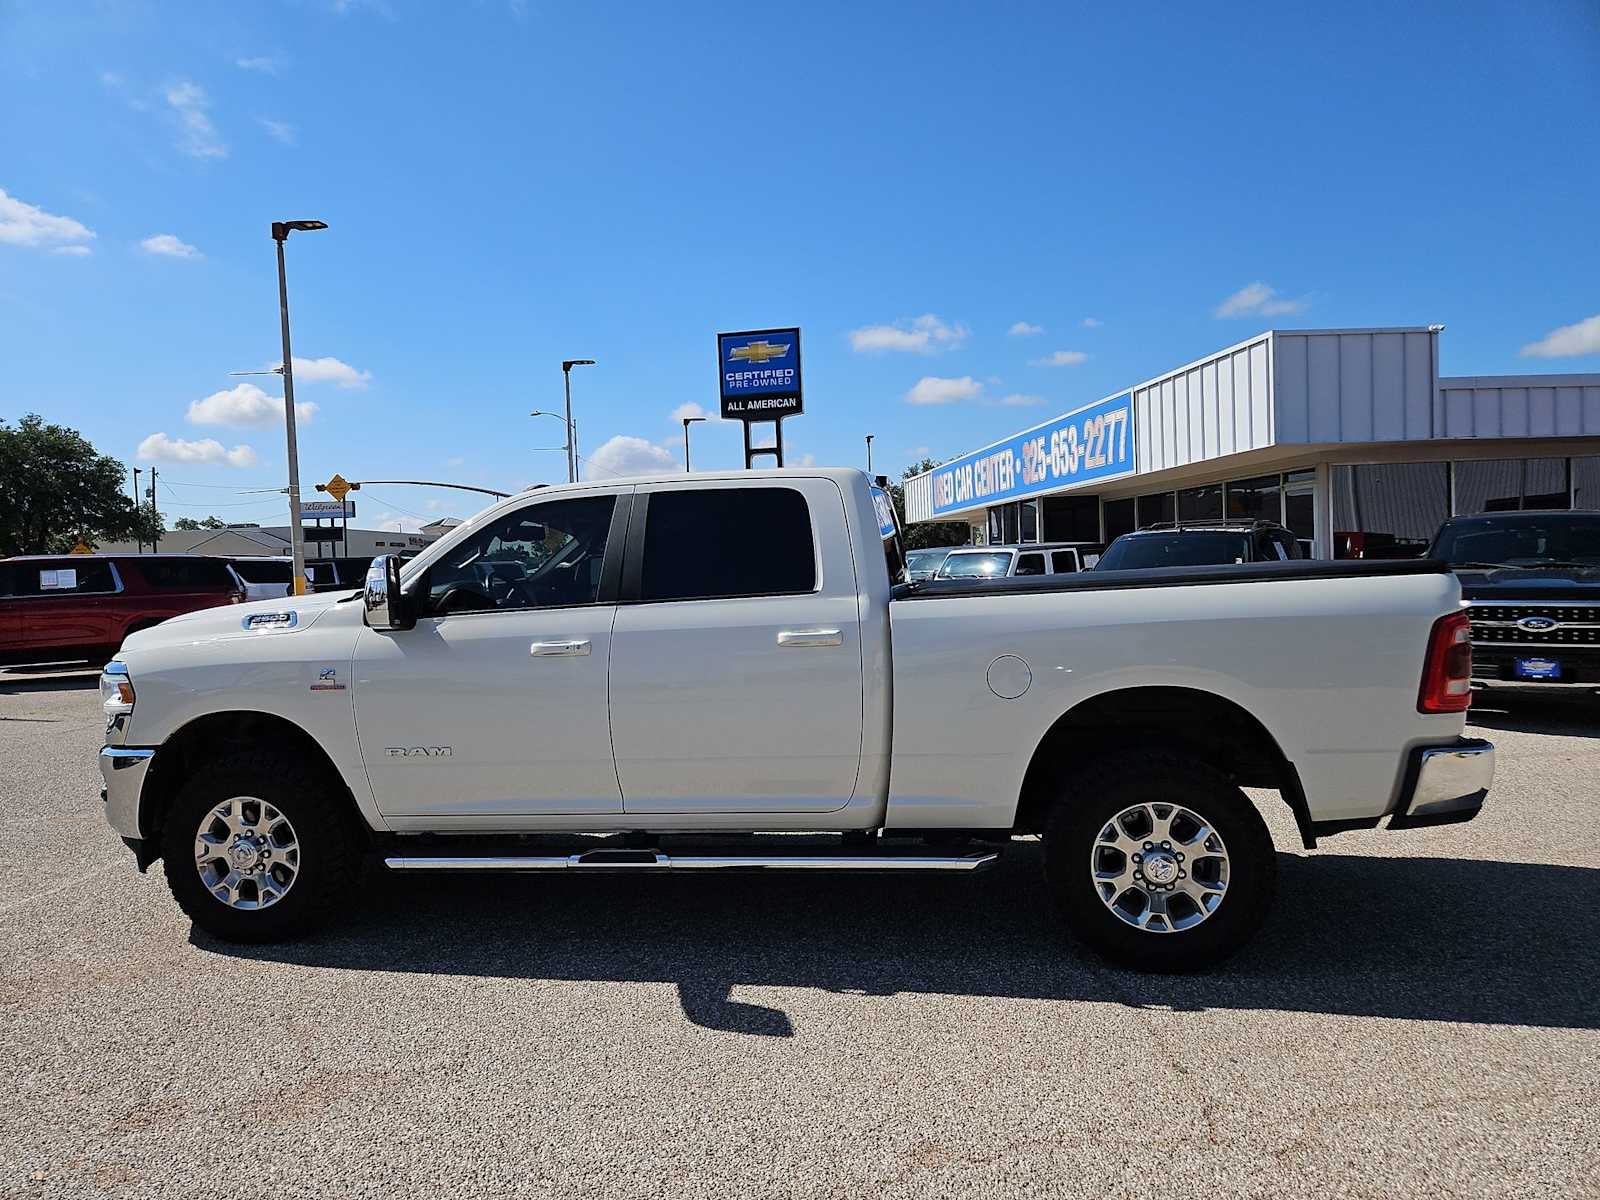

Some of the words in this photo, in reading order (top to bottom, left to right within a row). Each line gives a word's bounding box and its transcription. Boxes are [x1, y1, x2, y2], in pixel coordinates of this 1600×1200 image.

[726, 368, 794, 381] CERTIFIED
[729, 377, 791, 388] PRE-OWNED
[727, 401, 745, 411] ALL
[747, 398, 796, 410] AMERICAN
[934, 471, 954, 509] USED
[955, 463, 973, 503] CAR
[974, 448, 1015, 498] CENTER
[1527, 620, 1549, 628] Ford
[384, 746, 453, 757] RAM
